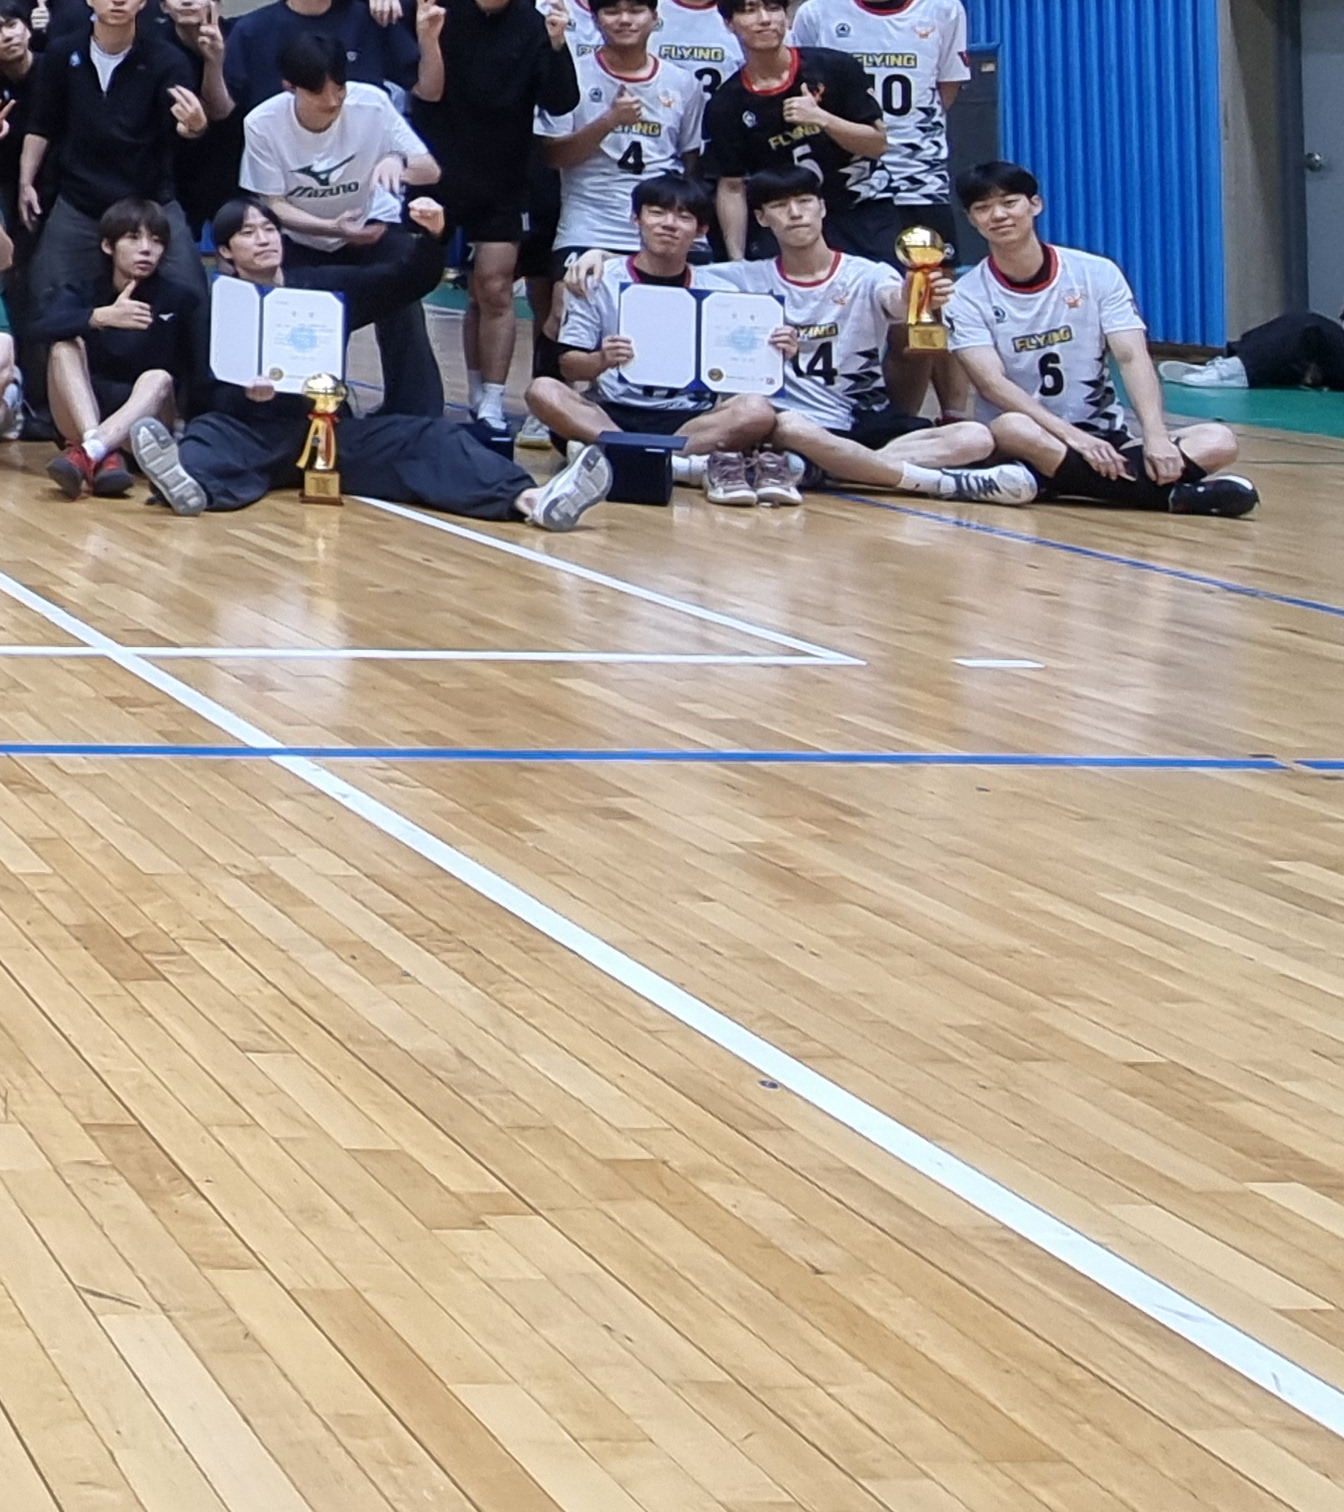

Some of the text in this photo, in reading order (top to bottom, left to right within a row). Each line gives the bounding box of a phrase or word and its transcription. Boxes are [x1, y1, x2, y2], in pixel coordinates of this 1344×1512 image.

[659, 45, 724, 62] FLYING
[617, 140, 646, 174] 4
[1012, 324, 1073, 353] FLYING
[1037, 351, 1065, 397] 6
